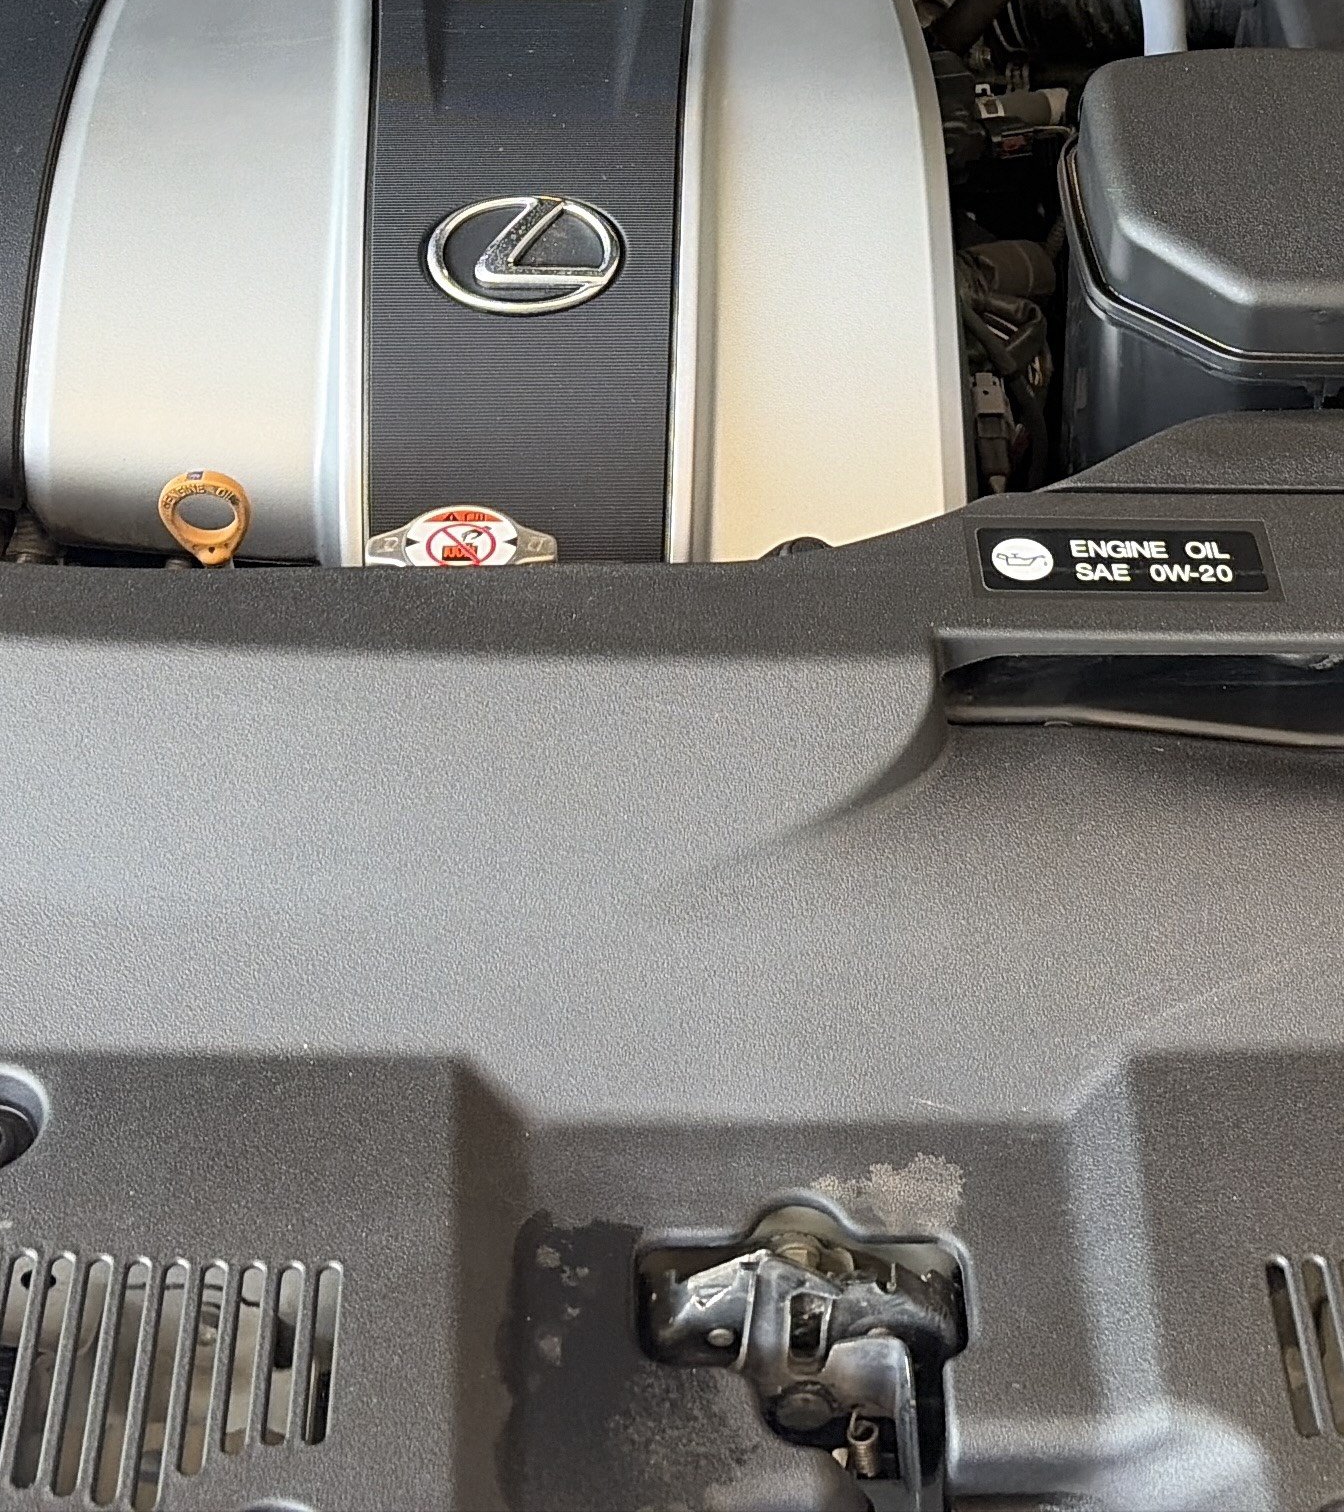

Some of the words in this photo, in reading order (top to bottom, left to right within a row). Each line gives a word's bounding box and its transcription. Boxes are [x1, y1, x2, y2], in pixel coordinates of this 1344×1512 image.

[163, 484, 207, 504] ENGINE
[1069, 539, 1169, 559] ENGINE
[1185, 541, 1231, 560] OIL
[1075, 563, 1131, 582] SAE
[1150, 564, 1234, 583] 0W-20
